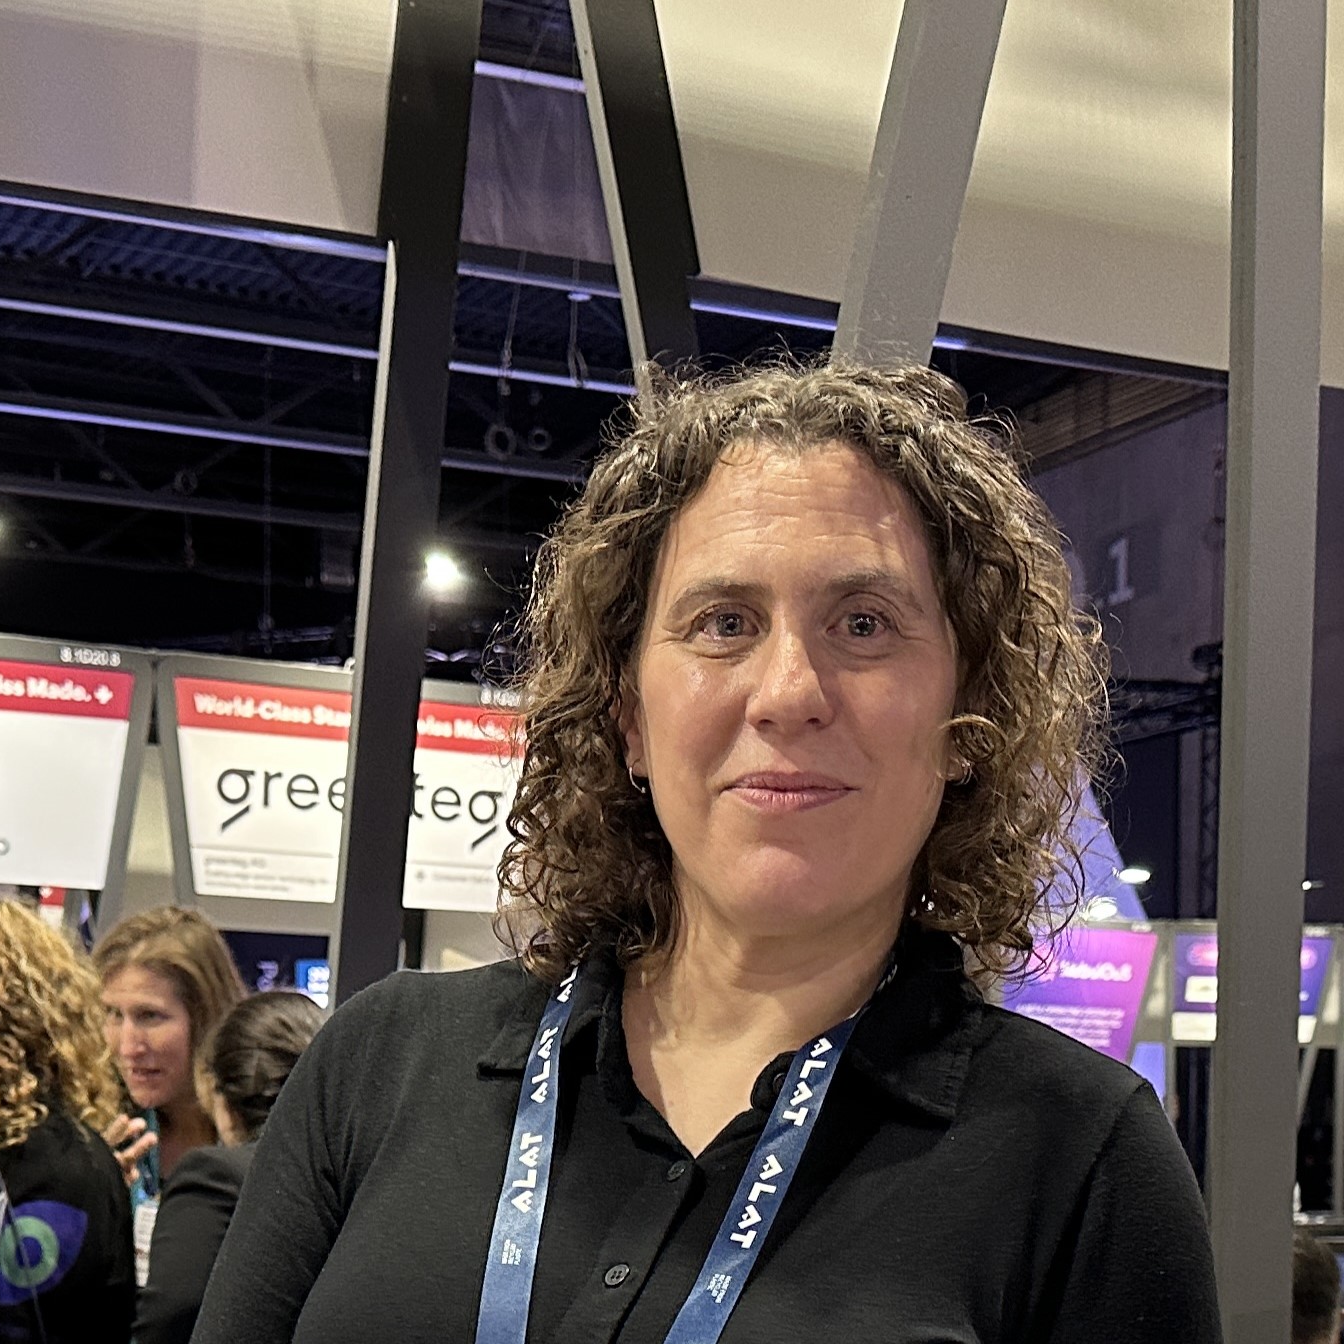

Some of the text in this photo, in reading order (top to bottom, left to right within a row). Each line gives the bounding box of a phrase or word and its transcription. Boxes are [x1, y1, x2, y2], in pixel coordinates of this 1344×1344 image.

[26, 678, 92, 704] Made.
[193, 692, 312, 724] World-Class
[530, 1026, 559, 1103] ALAT
[782, 1037, 833, 1127] ALAT
[511, 1132, 544, 1215] ALAT
[729, 1154, 783, 1249] ALAT
